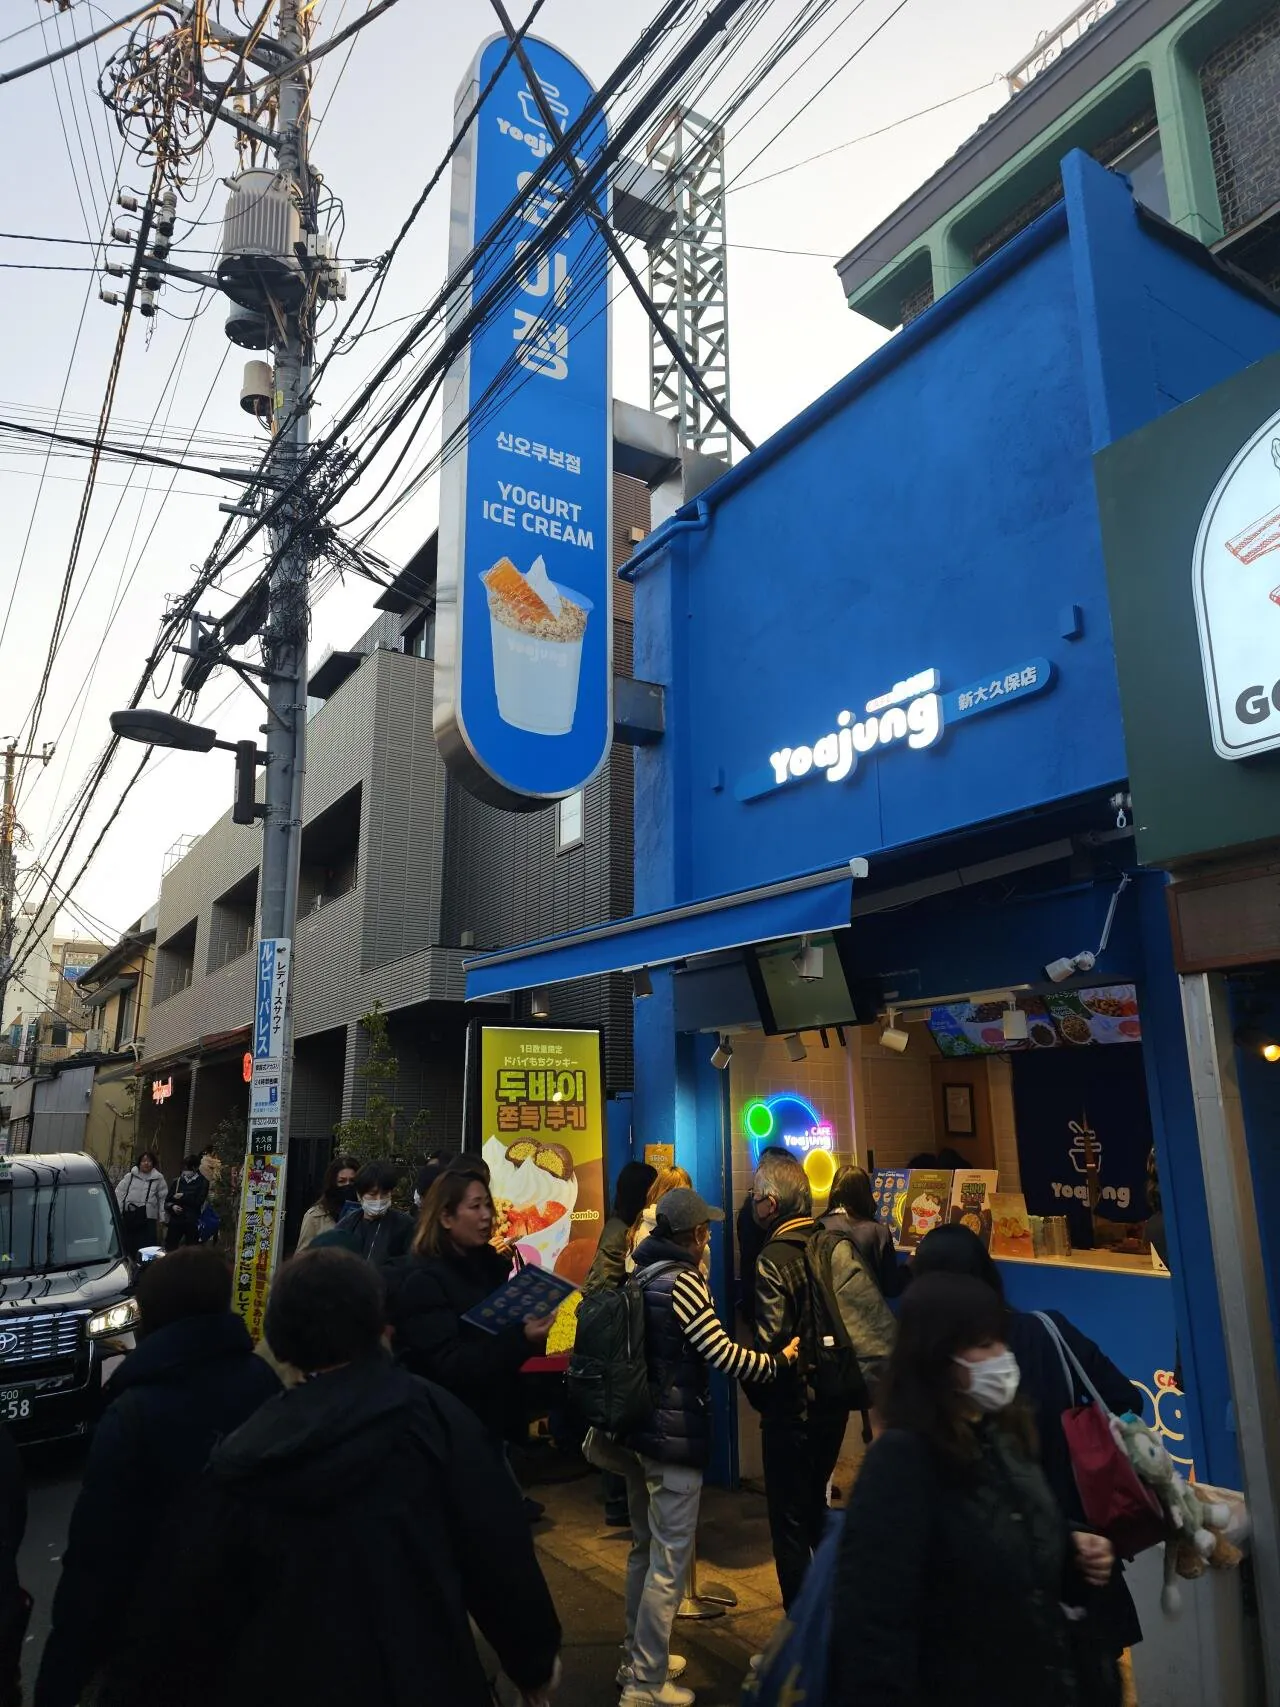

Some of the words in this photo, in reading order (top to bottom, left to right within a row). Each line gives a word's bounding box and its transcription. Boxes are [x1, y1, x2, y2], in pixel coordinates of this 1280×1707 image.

[496, 431, 581, 475] 신오쿠보점
[497, 480, 582, 523] YOGURT
[483, 500, 516, 528] ICE
[522, 512, 594, 550] CREAM
[959, 666, 1038, 711] 新大久保店
[769, 692, 941, 784] Yoajung
[257, 942, 274, 1054] ルビーパレス
[272, 961, 287, 1035] レディースサウナ
[504, 1056, 579, 1067] ドバイもちクッキー
[497, 1070, 585, 1103] 두바이
[546, 1105, 585, 1130] 쿠키
[811, 1126, 832, 1136] CAFE
[255, 1135, 273, 1144] 大久保
[255, 1144, 272, 1152] 1-16
[783, 1130, 832, 1151] Yoajung
[570, 1209, 600, 1221] combo
[1, 1390, 19, 1401] 500
